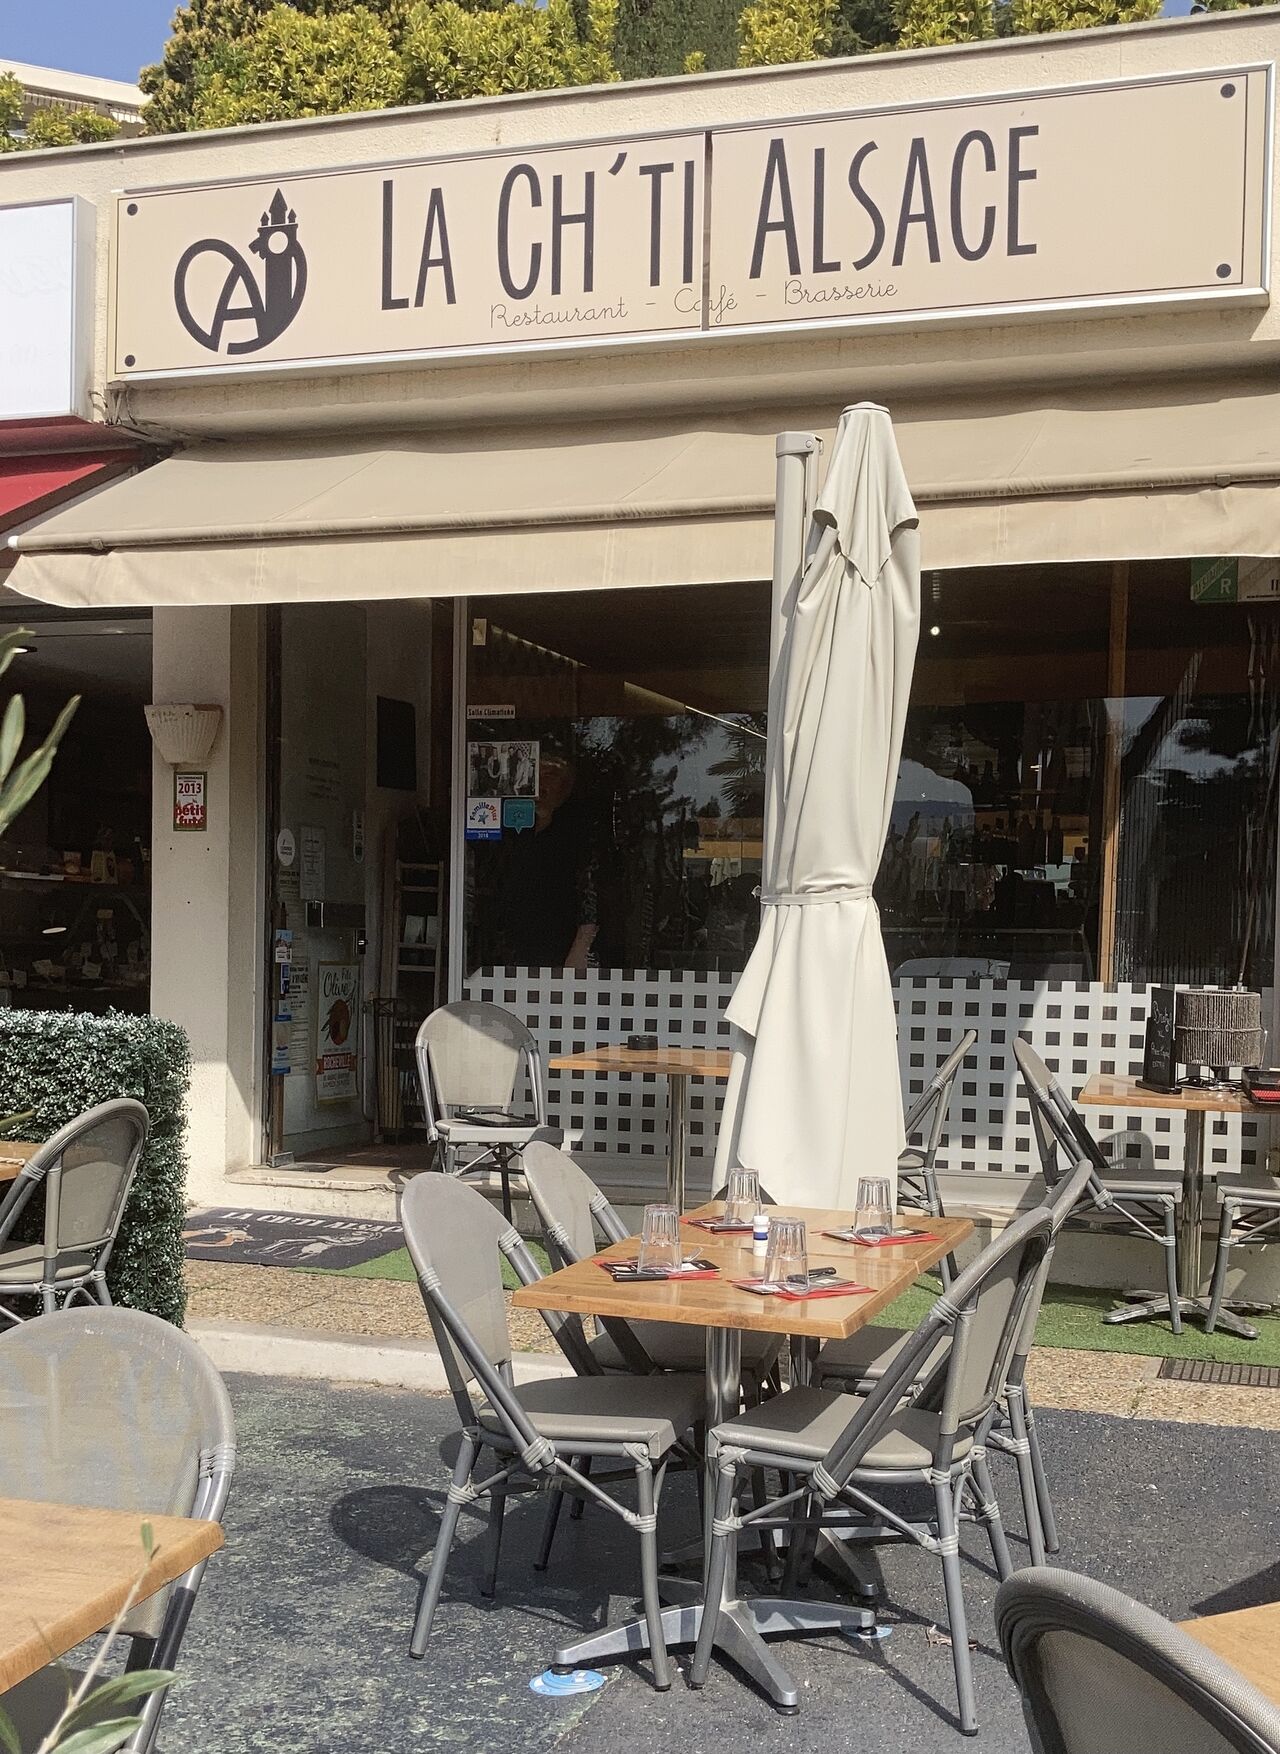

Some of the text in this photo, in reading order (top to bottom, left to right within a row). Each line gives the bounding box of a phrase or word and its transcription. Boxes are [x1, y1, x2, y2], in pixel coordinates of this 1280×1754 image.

[381, 125, 1039, 311] LA CH'TI ALSACE
[489, 295, 629, 329] Restaurant
[673, 284, 738, 324] Café
[783, 278, 899, 305] Brasserie
[178, 783, 202, 794] 2013
